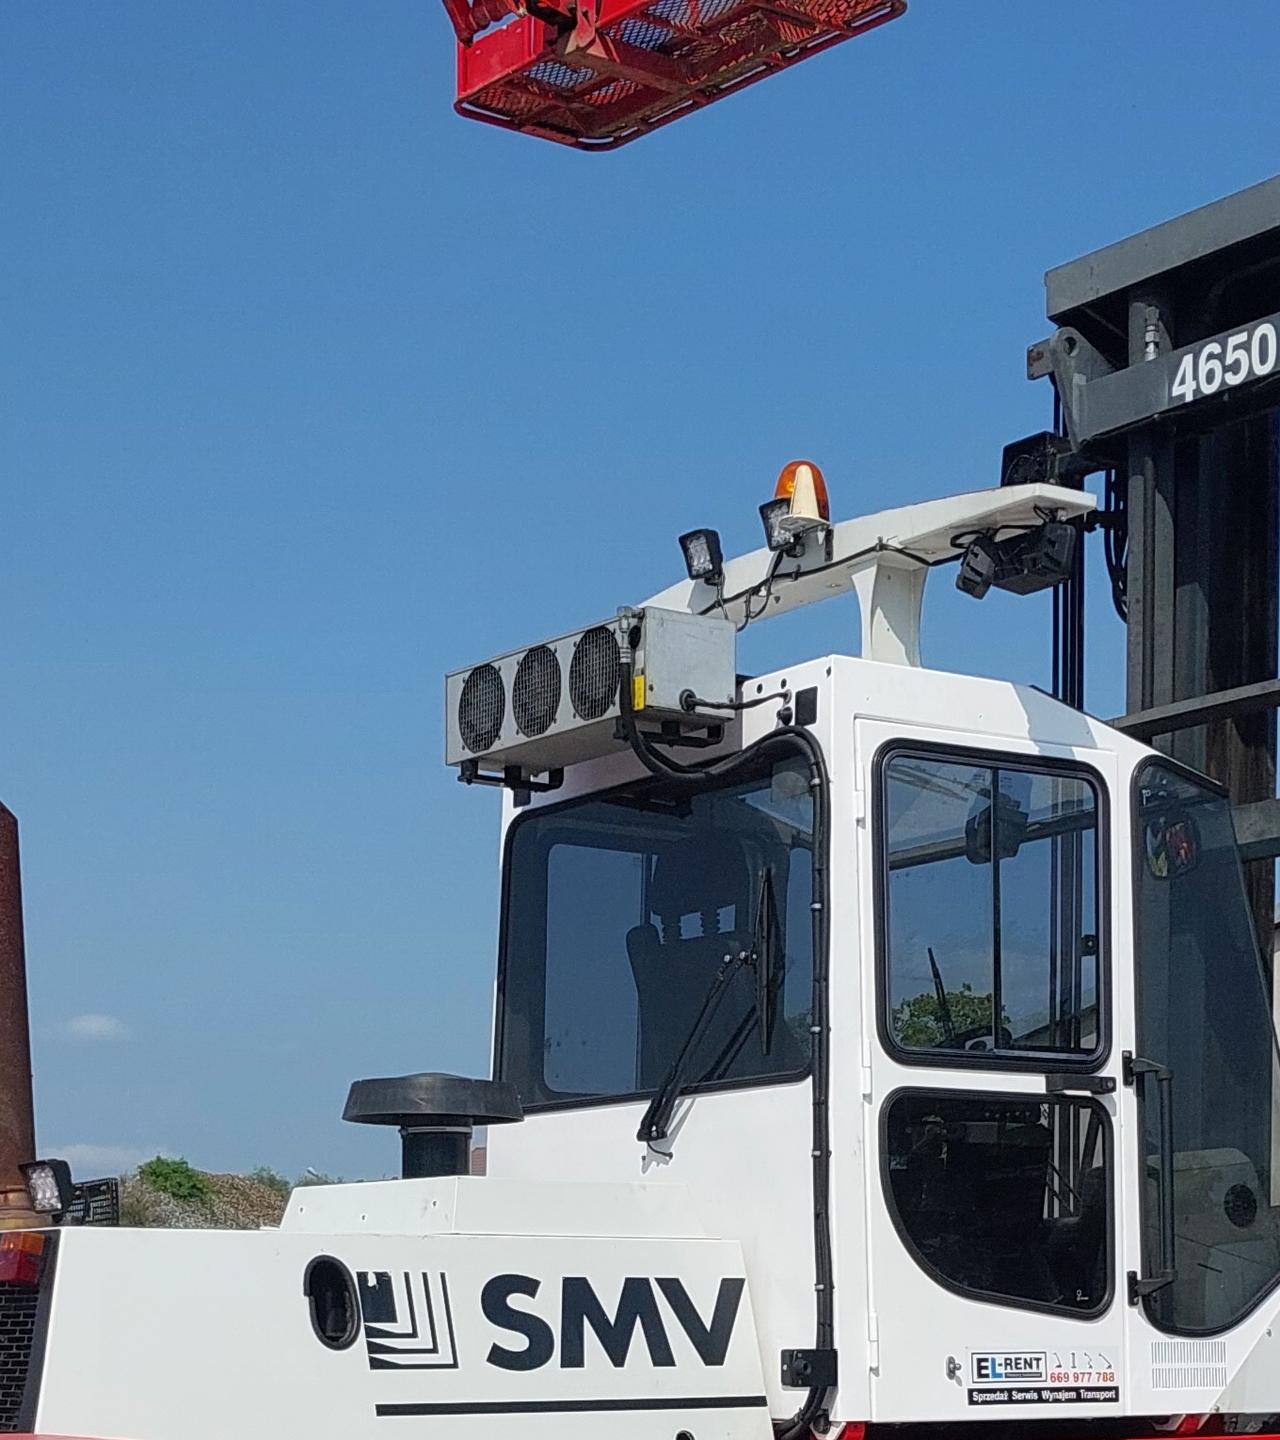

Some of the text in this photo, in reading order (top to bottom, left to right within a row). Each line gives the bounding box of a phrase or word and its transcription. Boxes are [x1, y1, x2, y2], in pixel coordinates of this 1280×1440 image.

[1172, 323, 1277, 402] 4650
[480, 1273, 746, 1372] SMV
[976, 1357, 1042, 1379] EL-RENT
[1050, 1372, 1069, 1383] 669
[1073, 1372, 1092, 1383] 977
[1096, 1371, 1115, 1383] 788
[972, 1389, 1116, 1402] Sprzedaż Serwis Wynajem Transport
